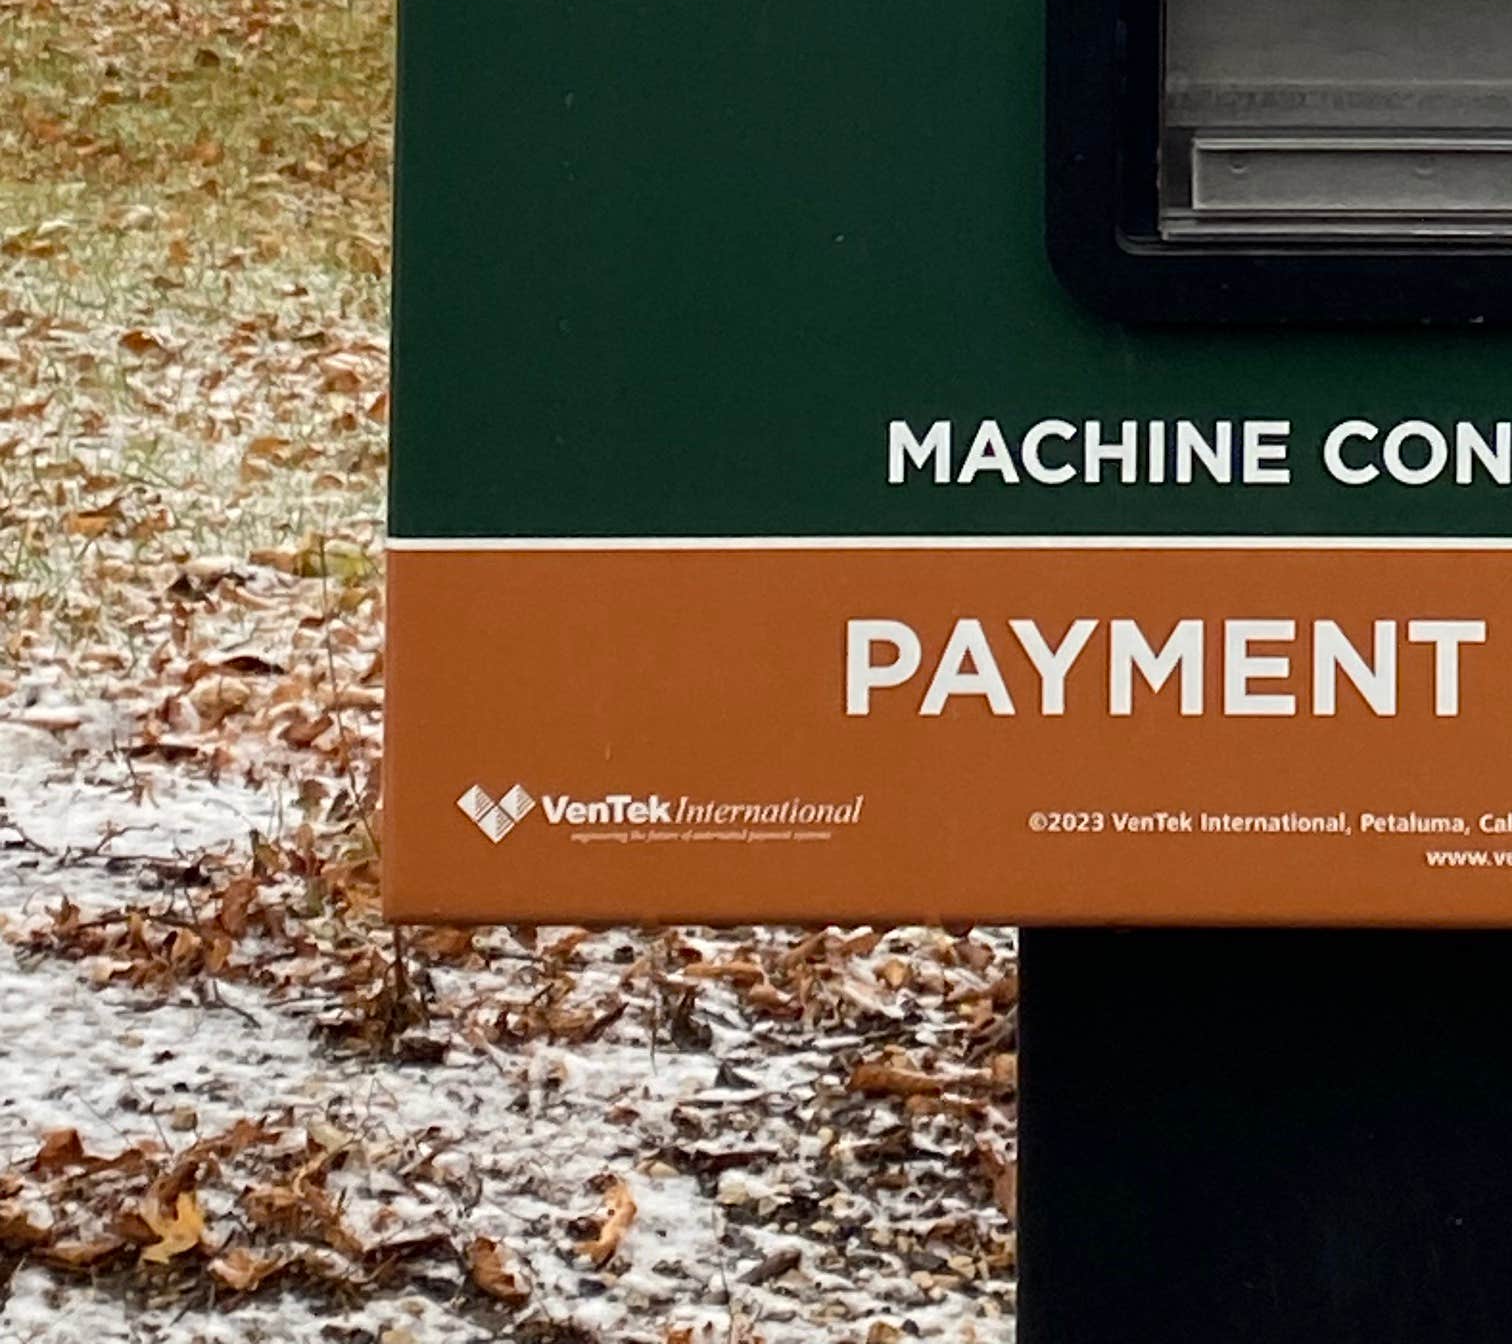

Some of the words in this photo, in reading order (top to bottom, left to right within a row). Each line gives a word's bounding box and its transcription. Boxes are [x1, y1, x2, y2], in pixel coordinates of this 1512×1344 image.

[888, 419, 1291, 484] MACHINE
[846, 618, 1486, 716] PAYMENT
[541, 795, 673, 824] VenTek
[675, 795, 864, 824] International
[1028, 811, 1105, 832] ©2023
[1111, 811, 1193, 832] VenTek
[1200, 811, 1352, 836] International,
[1360, 811, 1471, 836] Petaluma,
